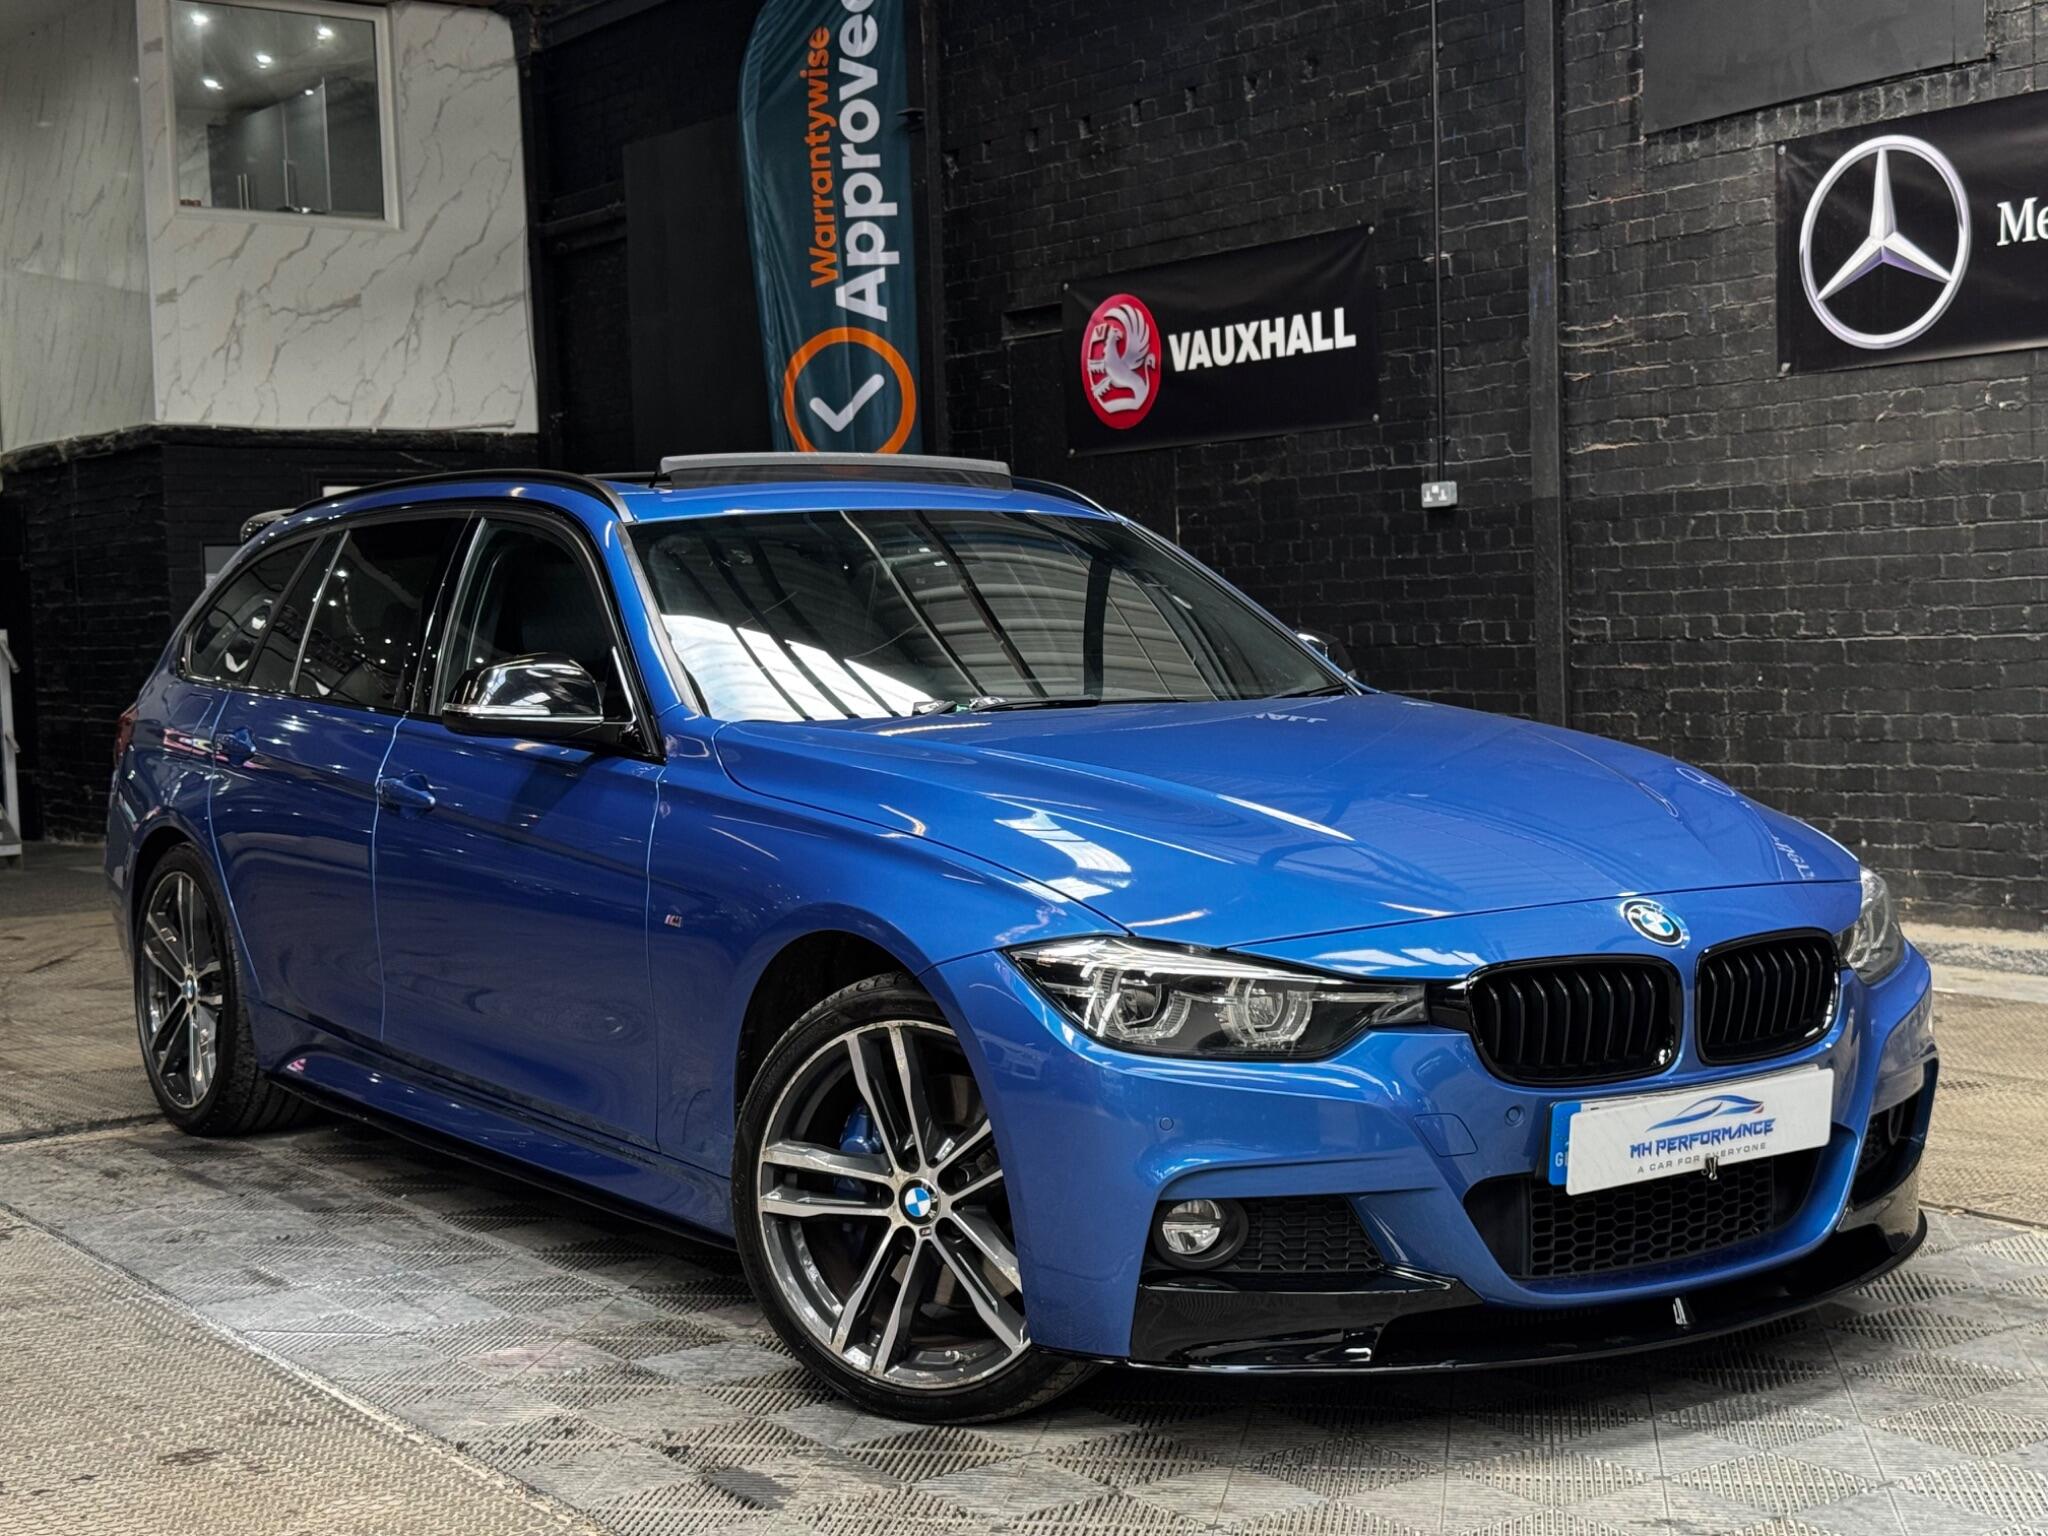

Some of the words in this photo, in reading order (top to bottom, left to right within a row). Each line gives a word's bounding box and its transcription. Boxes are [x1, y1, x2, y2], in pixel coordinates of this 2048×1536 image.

[801, 25, 839, 288] Warrantywise
[1168, 307, 1357, 372] VAUXHALL
[1629, 1140, 1653, 1159] MH
[1655, 1118, 1776, 1156] PERFORMANCE
[1637, 1165, 1645, 1173] A
[1649, 1160, 1673, 1171] CAR
[1677, 1154, 1701, 1166] FOR
